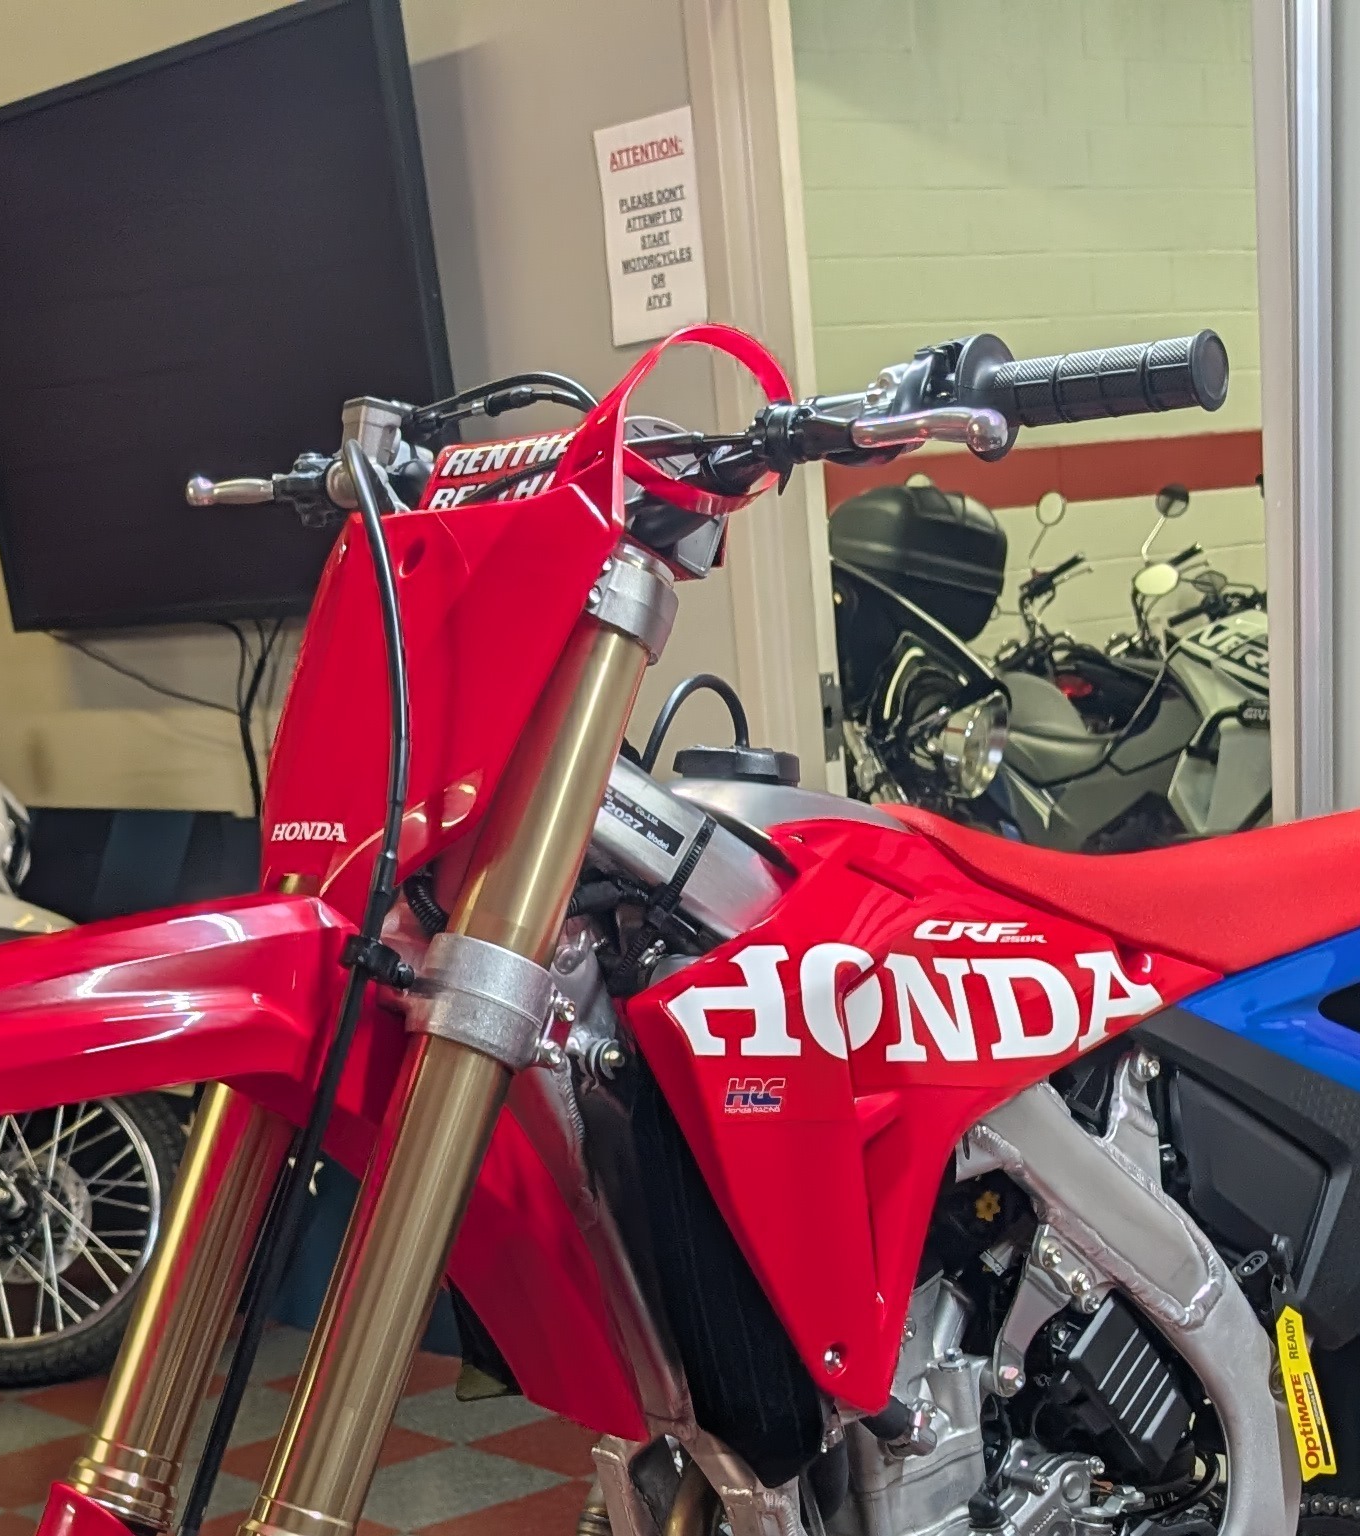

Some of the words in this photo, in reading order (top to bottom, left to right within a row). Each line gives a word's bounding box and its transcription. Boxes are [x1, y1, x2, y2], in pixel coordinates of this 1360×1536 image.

[610, 136, 684, 171] ATTENTION:
[619, 191, 655, 213] PLEASE
[626, 210, 667, 232] ATTEMPT
[670, 207, 682, 223] TO
[641, 231, 670, 249] START
[622, 247, 692, 274] MOTORCYCLES
[651, 273, 666, 289] OR
[271, 821, 347, 843] HONDA
[603, 800, 644, 829] 2027
[646, 831, 670, 850] Model
[913, 919, 1028, 942] CRF
[667, 942, 1163, 1062] HONDA
[724, 1077, 786, 1107] HRC
[1285, 1317, 1300, 1360] READY
[1290, 1373, 1321, 1469] OptiMATE
